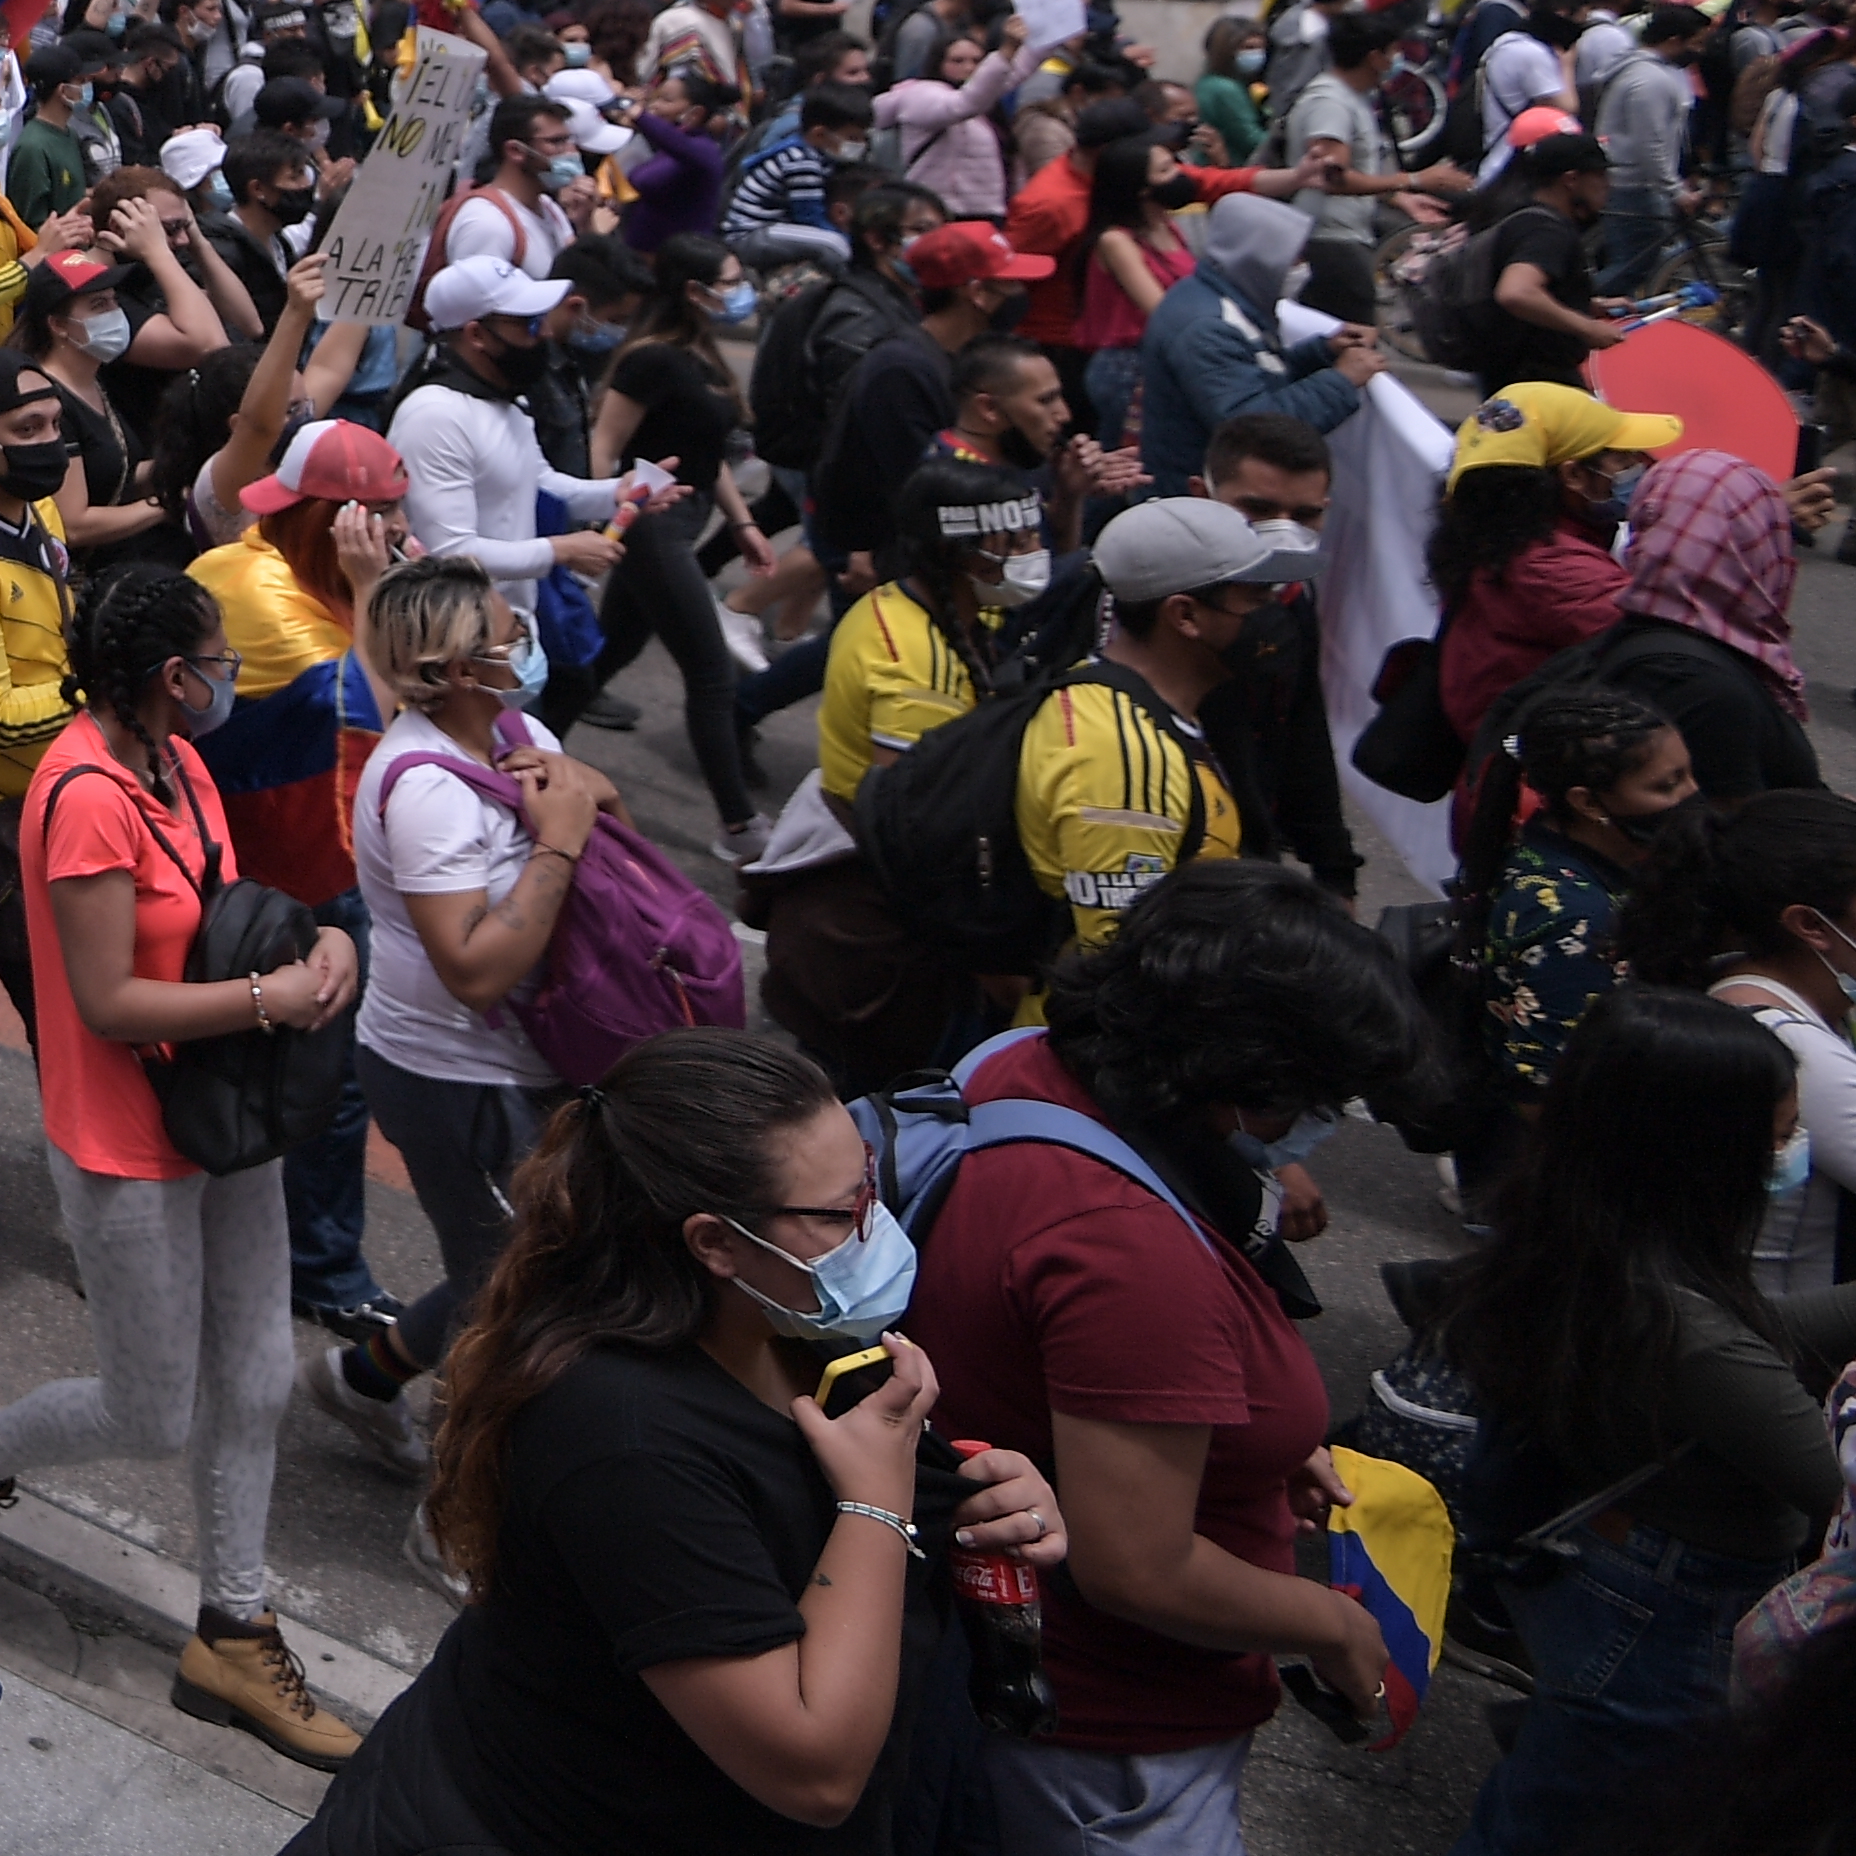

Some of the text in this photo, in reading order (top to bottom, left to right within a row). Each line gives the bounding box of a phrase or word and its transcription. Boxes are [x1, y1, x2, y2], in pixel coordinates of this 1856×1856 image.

[376, 111, 427, 158] NO
[350, 237, 384, 274] LA
[977, 499, 1024, 532] NO
